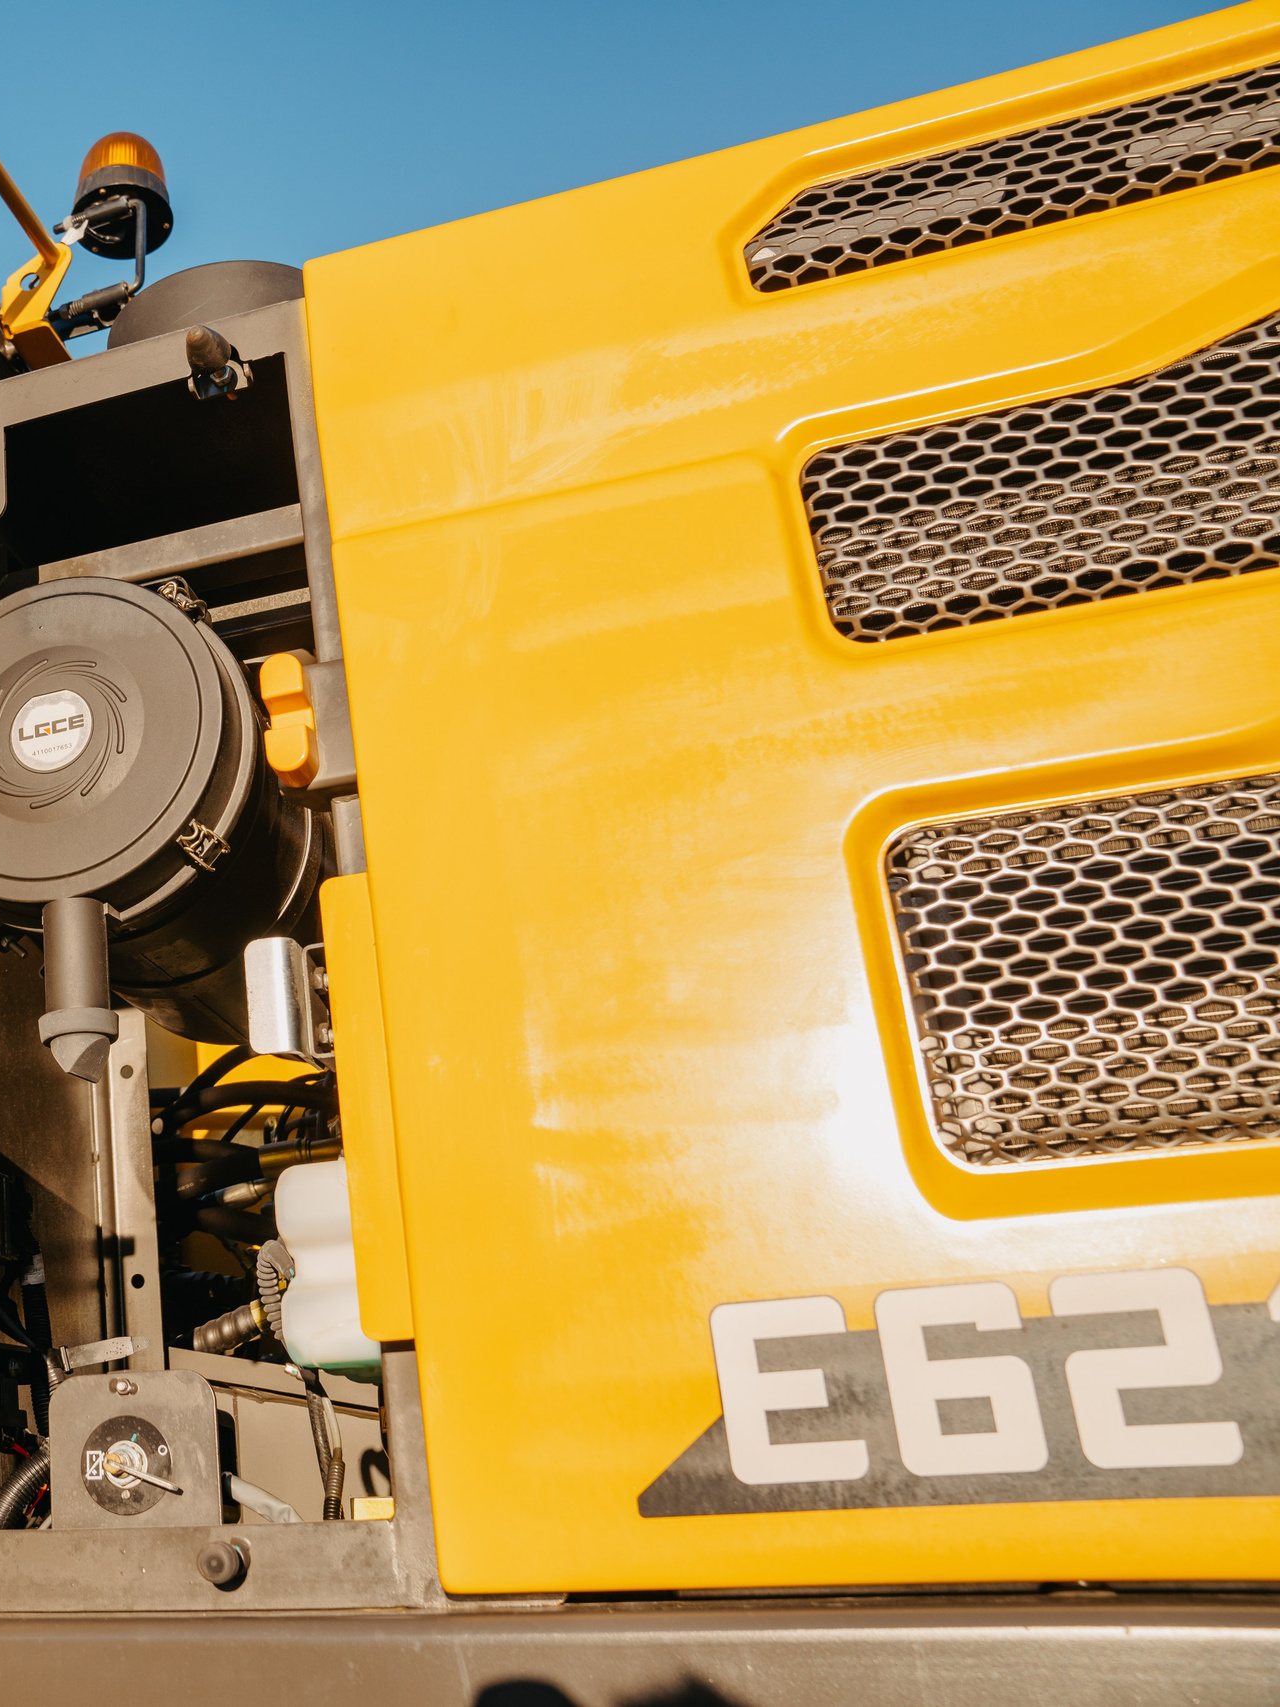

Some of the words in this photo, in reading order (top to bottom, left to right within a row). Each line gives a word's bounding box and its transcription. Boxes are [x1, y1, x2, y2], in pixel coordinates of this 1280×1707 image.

[19, 714, 84, 741] LGCE
[32, 743, 73, 756] 4110017653
[709, 1268, 1280, 1486] E62
